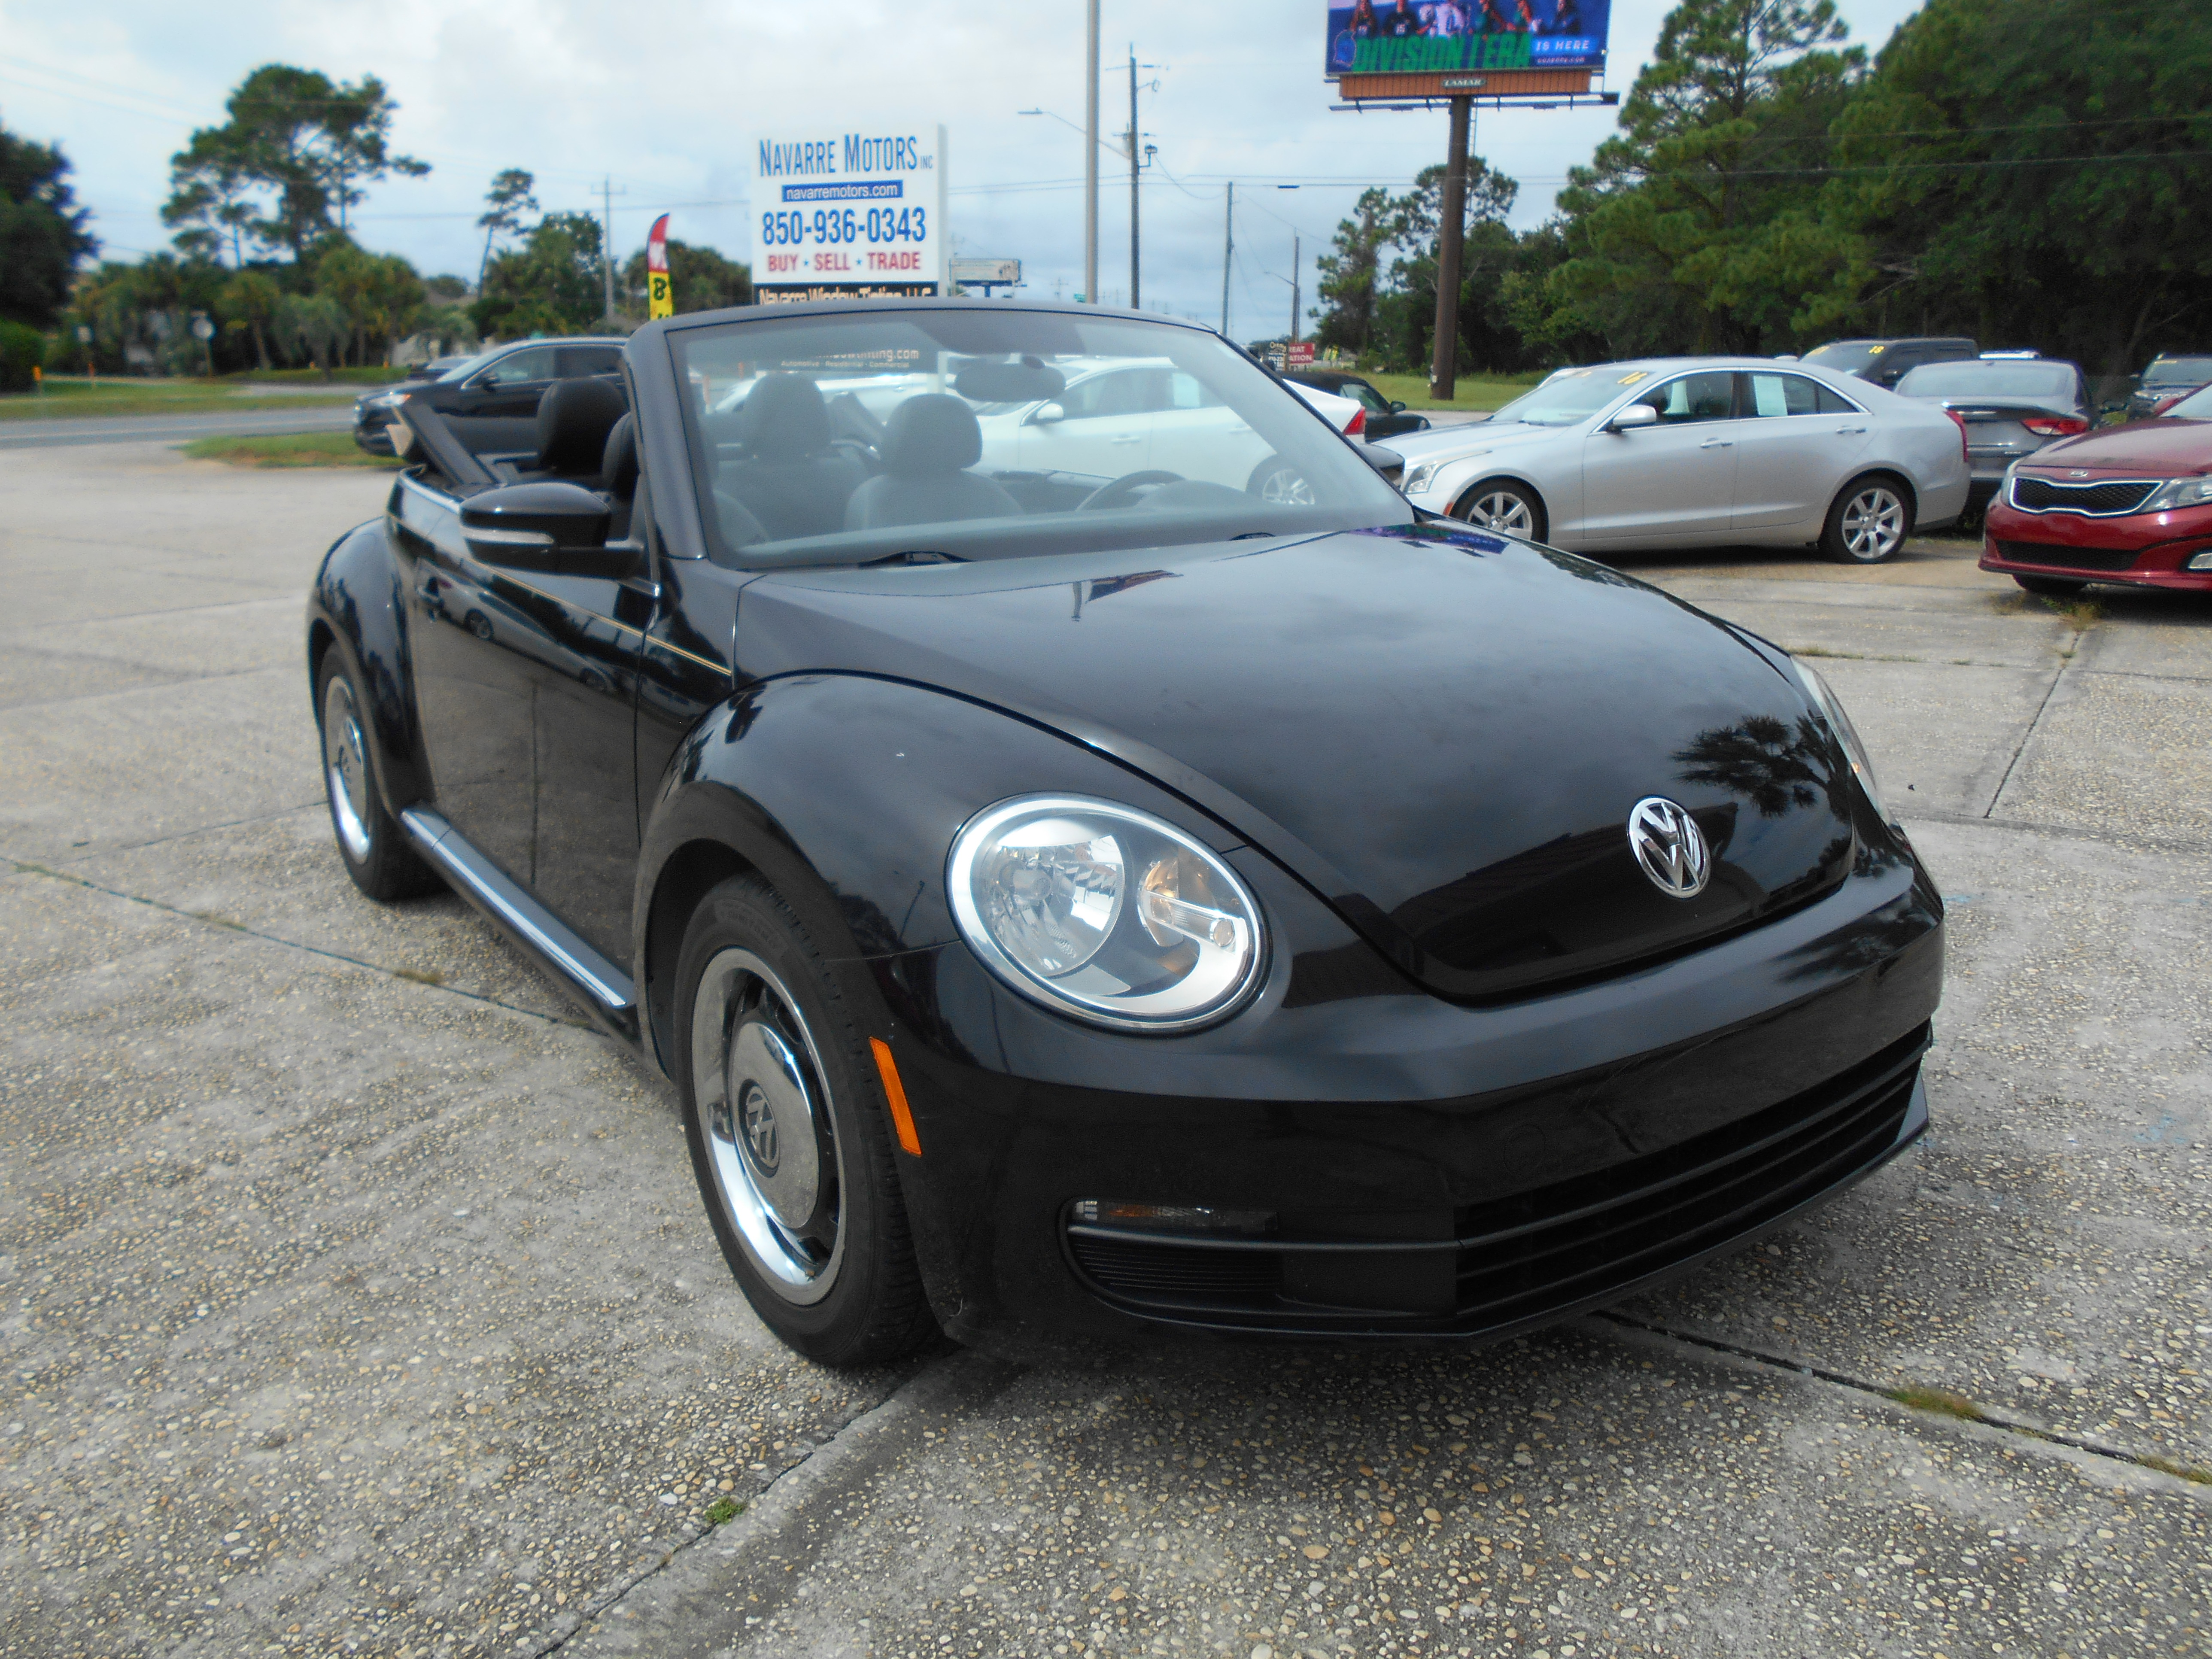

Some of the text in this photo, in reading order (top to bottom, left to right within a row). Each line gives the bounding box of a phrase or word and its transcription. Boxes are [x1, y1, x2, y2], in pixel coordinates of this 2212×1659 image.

[1352, 35, 1465, 72] DIVISION
[1483, 33, 1532, 68] ERA
[1536, 40, 1589, 51] IS HERE
[760, 133, 933, 176] NAVARRE MOTORS INC
[786, 183, 898, 200] navarremotors.com
[763, 207, 926, 245] 850-936-0343
[768, 251, 921, 272] BUY SELL TRADE
